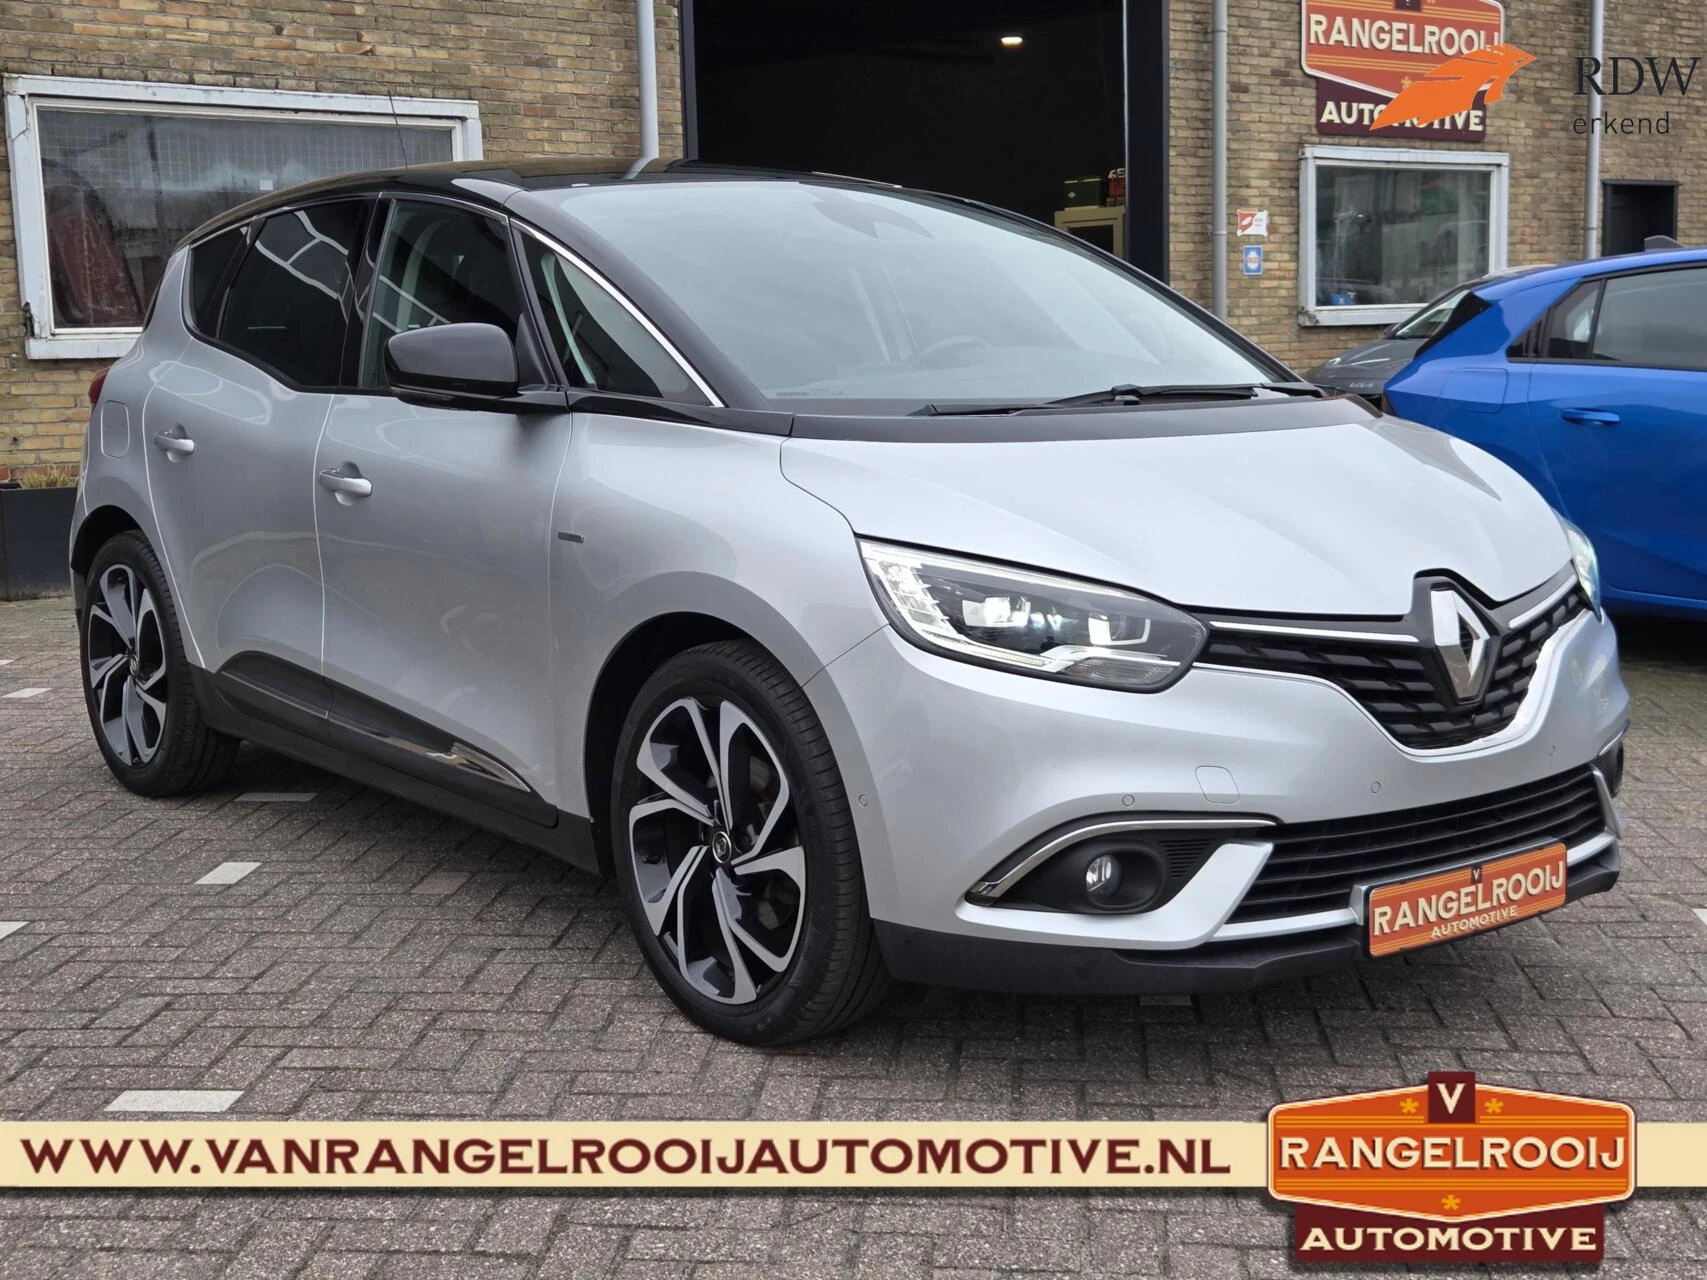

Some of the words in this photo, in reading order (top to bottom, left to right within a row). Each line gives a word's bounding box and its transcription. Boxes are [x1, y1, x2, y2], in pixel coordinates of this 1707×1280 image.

[1473, 868, 1481, 881] V
[1373, 860, 1565, 936] RANGELROOIJ
[1431, 904, 1518, 939] AUTOMOTIVE
